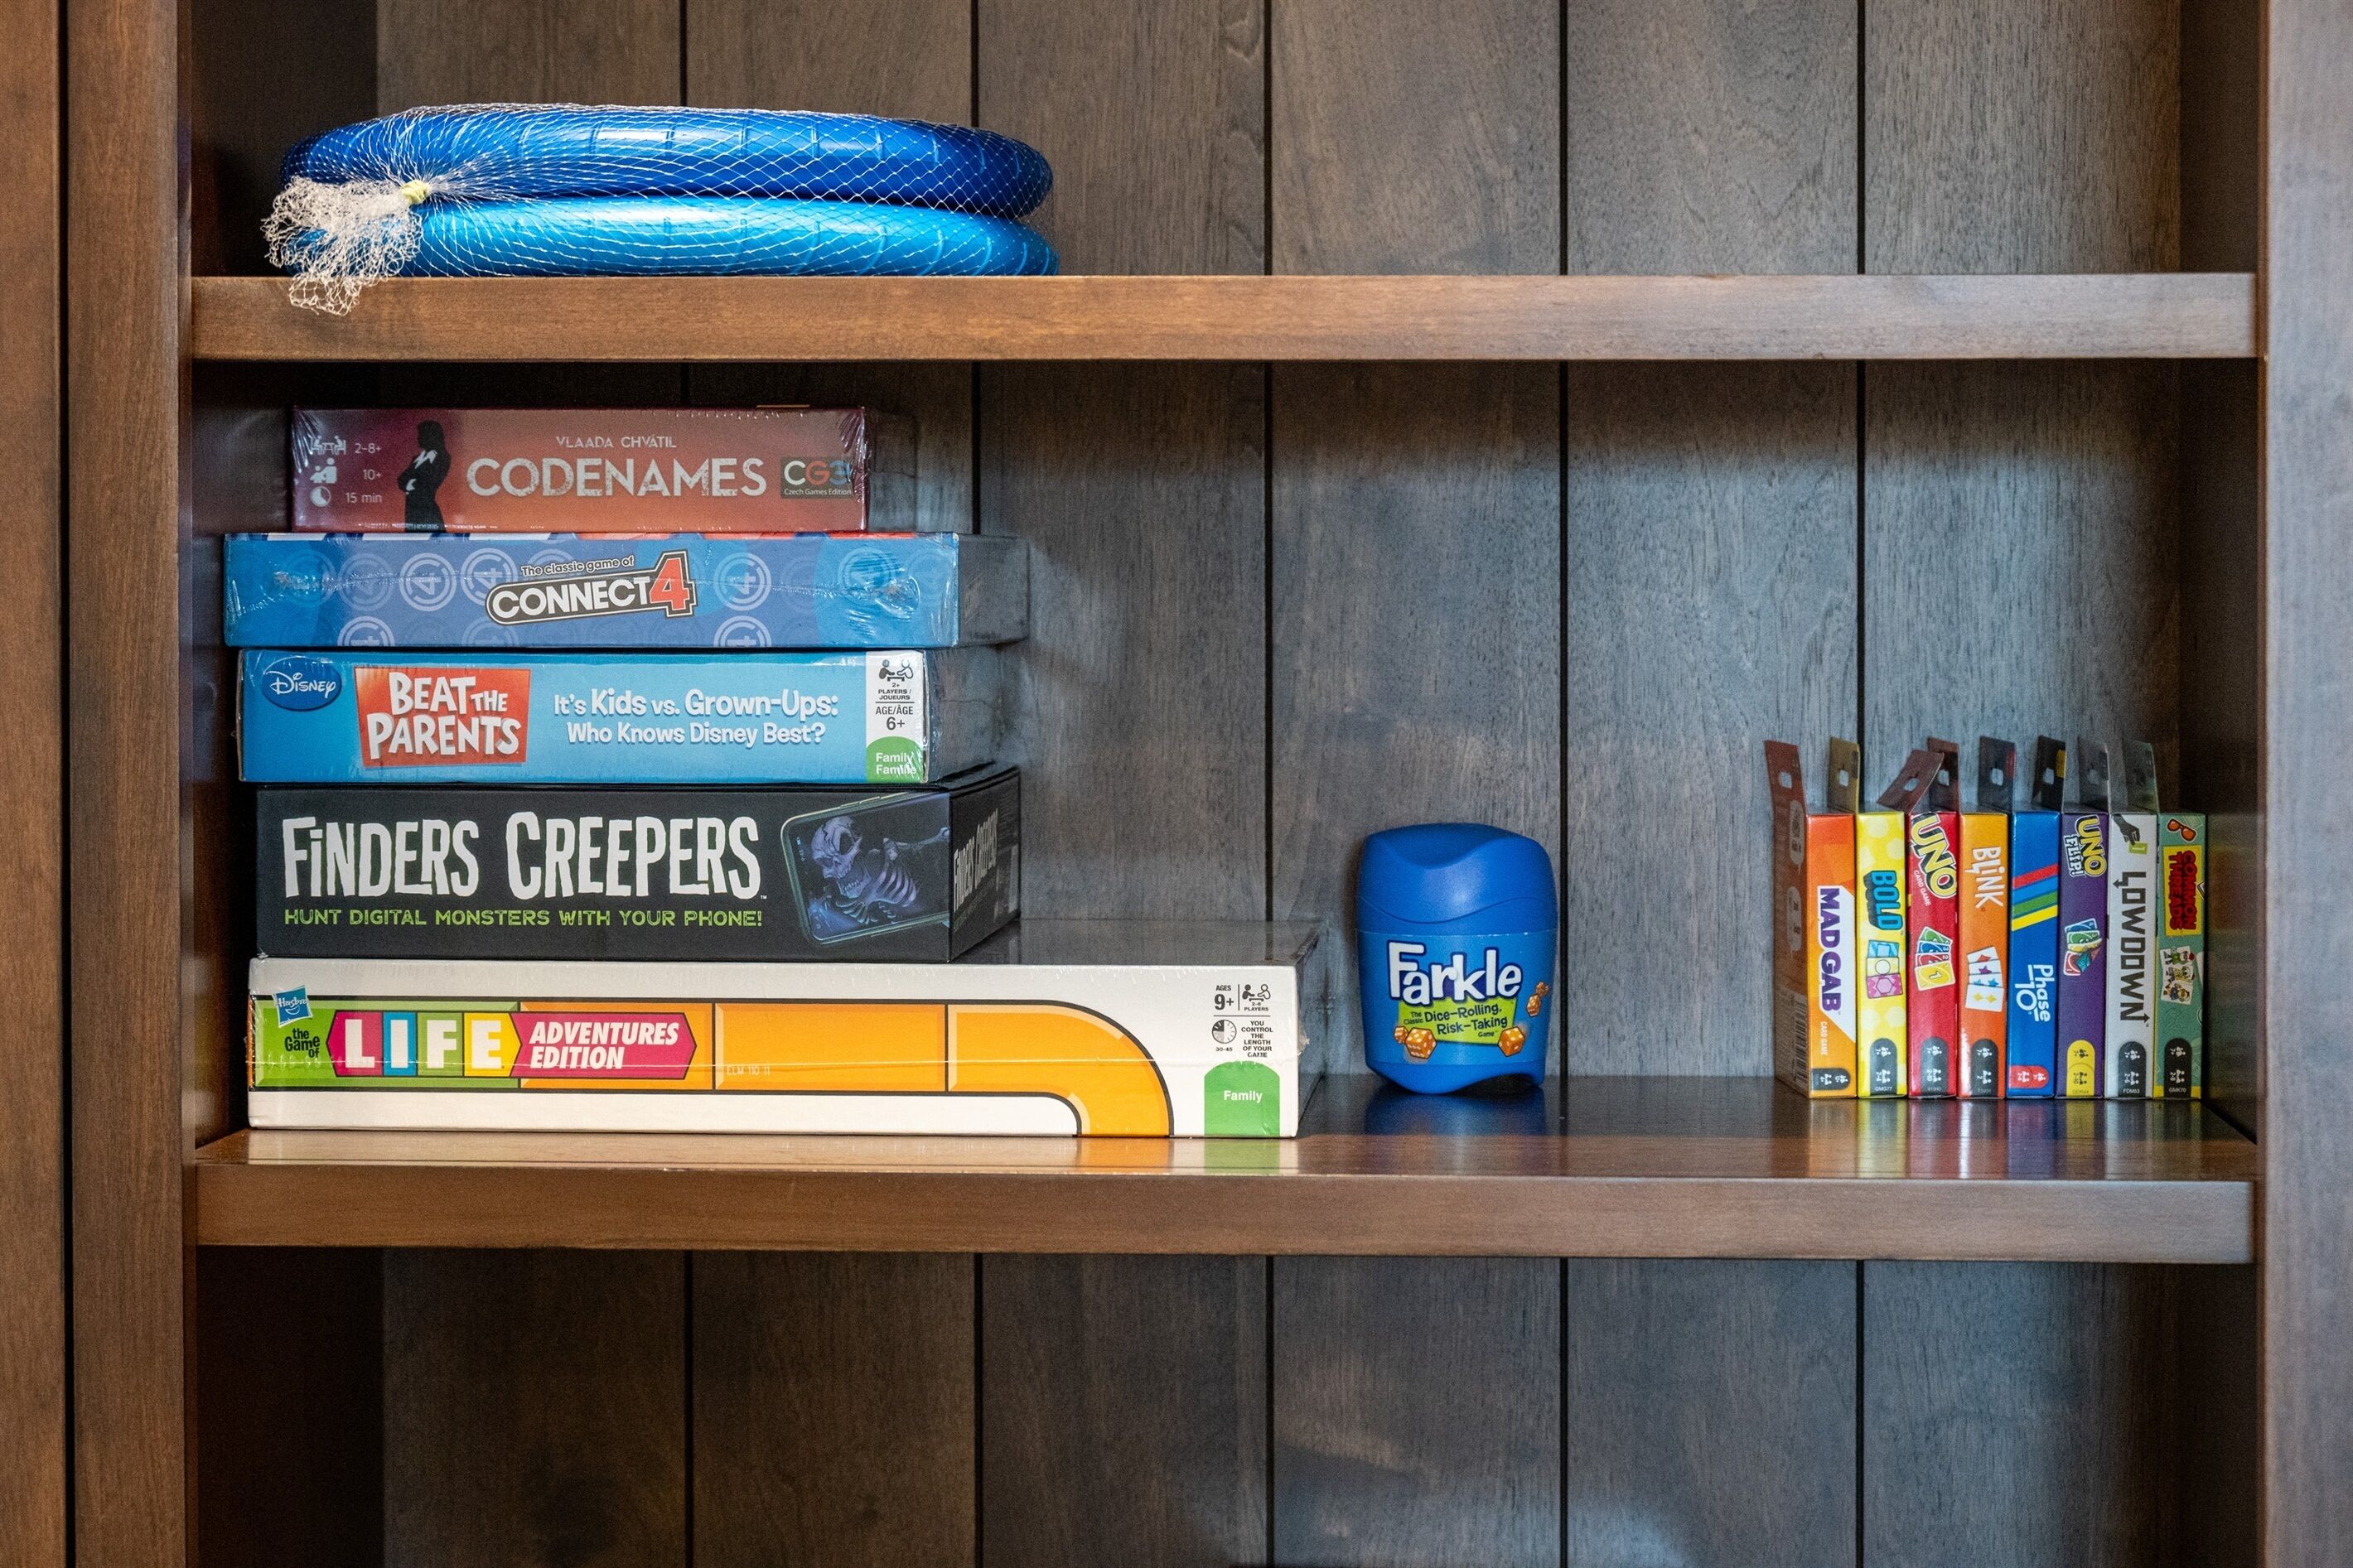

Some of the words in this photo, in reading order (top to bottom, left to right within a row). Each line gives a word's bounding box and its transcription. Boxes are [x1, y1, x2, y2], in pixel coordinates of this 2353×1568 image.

[354, 442, 382, 454] 2-8+
[556, 435, 614, 448] VLAADA
[621, 433, 677, 448] CHVÁTIL
[362, 469, 382, 480] 10+
[466, 457, 768, 497] CODENAMES
[345, 492, 358, 504] 15
[361, 492, 383, 504] min
[521, 565, 543, 577] The
[544, 561, 584, 576] classic
[586, 557, 620, 573] game
[621, 554, 635, 567] of
[491, 576, 651, 619] CONNECT
[649, 557, 691, 611] 4
[388, 672, 476, 716] BEAT
[470, 689, 509, 712] THE
[591, 688, 648, 716] Kids
[651, 697, 681, 716] vs.
[684, 688, 839, 722] Grown-Ups:
[875, 704, 914, 715] AGE/ÂGE
[886, 716, 906, 731] 6+
[366, 713, 522, 760] PARENTS
[566, 721, 613, 744] Who
[617, 721, 686, 744] Knows
[689, 721, 759, 749] Disney
[762, 721, 827, 744] Best?
[875, 752, 914, 765] Family
[505, 811, 761, 900] CREEPERS
[1911, 813, 1957, 898] UNO
[2064, 835, 2085, 877] FLIP!
[2076, 815, 2107, 877] UNO
[1867, 870, 1904, 931] BOLD
[1914, 870, 1924, 888] CARD
[1921, 887, 1932, 907] GAME
[2168, 851, 2183, 930] THREADS
[2181, 850, 2196, 929] COMMON
[284, 909, 342, 926] HUNT
[349, 909, 428, 926] DIGITAL
[435, 909, 550, 927] MONSTERS
[558, 909, 611, 927] WITH
[619, 909, 676, 927] YOUR
[684, 910, 762, 927] PHONE!
[1819, 887, 1841, 948] MAD
[2117, 871, 2149, 1022] LOWDOWN
[1387, 941, 1523, 1006] Farkle
[1820, 951, 1842, 1011] GAB
[278, 996, 309, 1008] Hasbro
[1214, 993, 1234, 1011] 9+
[2015, 982, 2037, 1011] 10
[2034, 964, 2055, 1022] Phase
[292, 1028, 309, 1040] the
[529, 1021, 679, 1045] ADVENTURES
[1436, 1016, 1509, 1035] Risk-Taking
[1819, 1020, 1828, 1037] CARD
[284, 1034, 321, 1052] Game
[308, 1046, 320, 1059] of
[344, 1019, 503, 1069] LIFE
[529, 1045, 626, 1069] EDITION
[1819, 1038, 1829, 1056] GAME
[1223, 1090, 1263, 1103] Family
